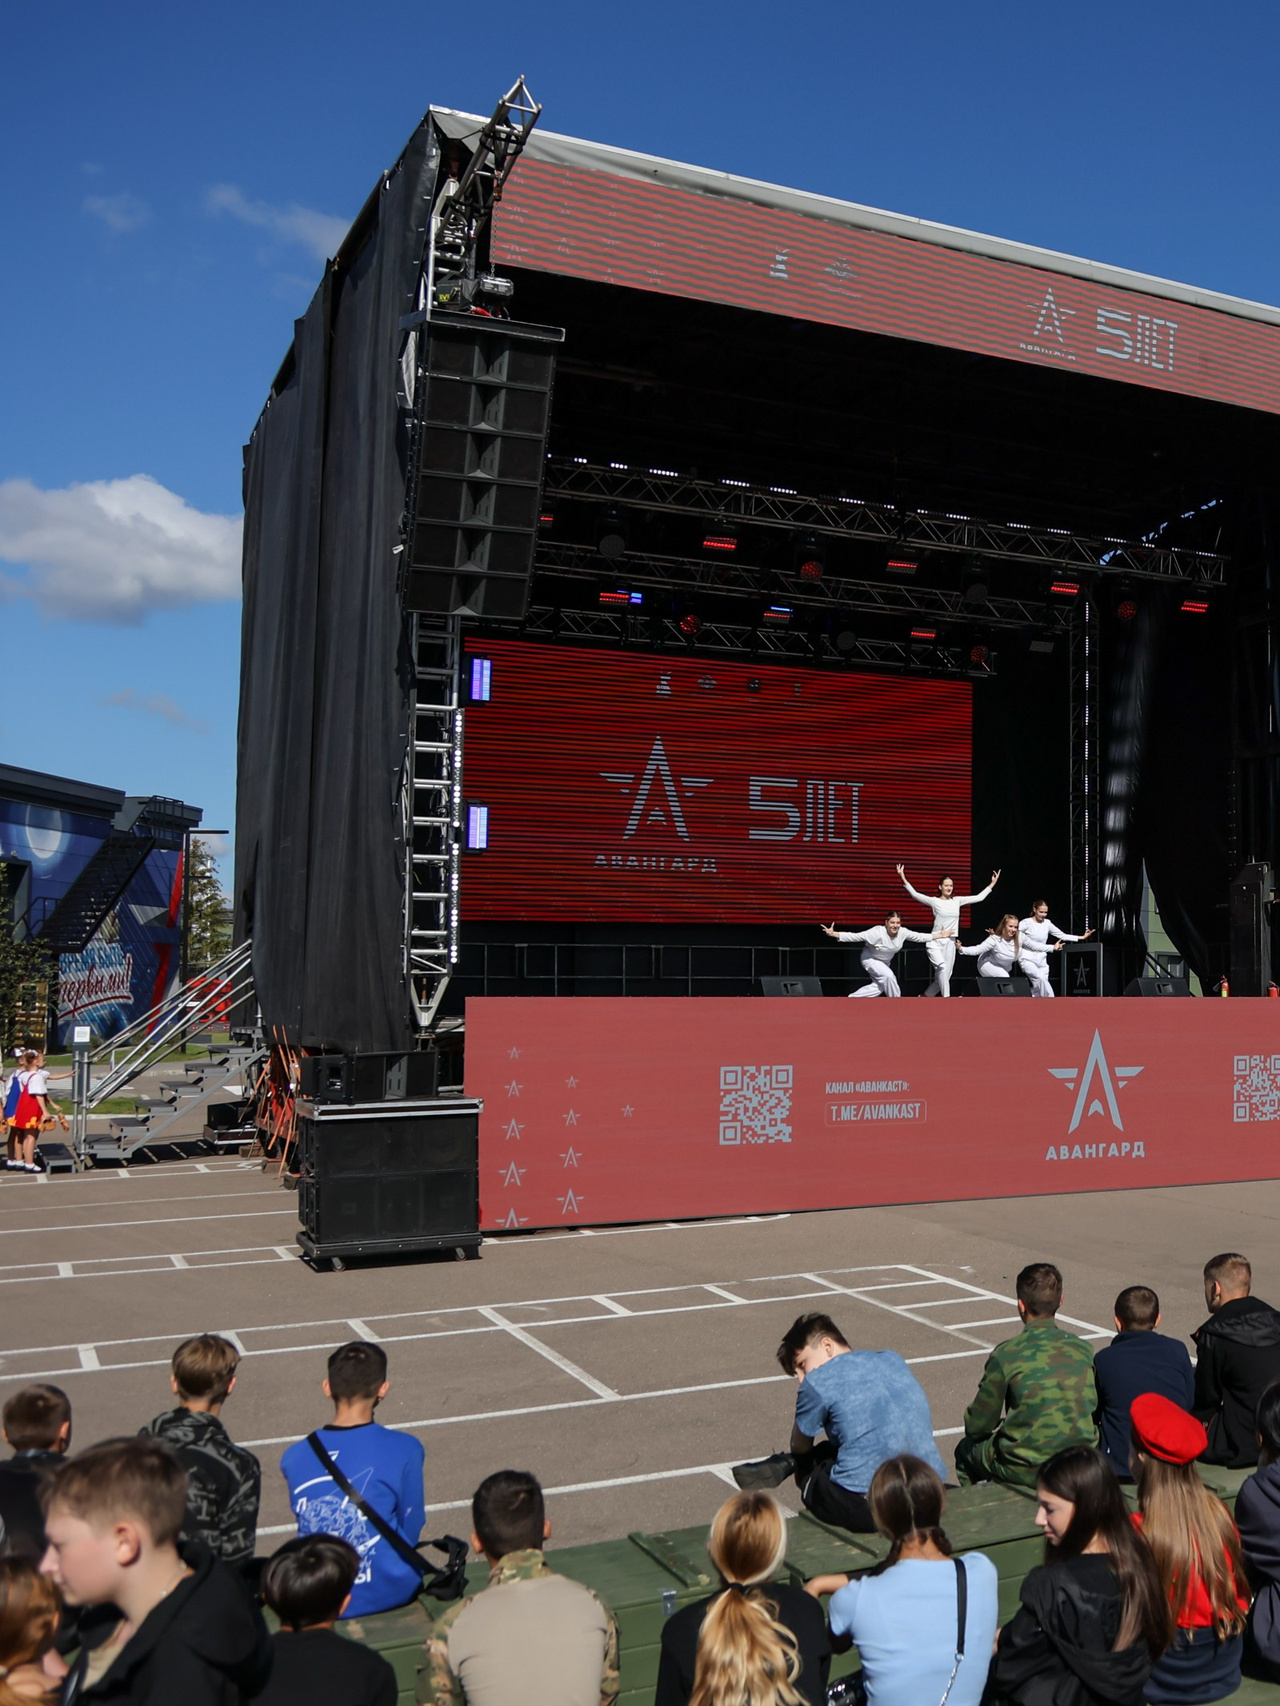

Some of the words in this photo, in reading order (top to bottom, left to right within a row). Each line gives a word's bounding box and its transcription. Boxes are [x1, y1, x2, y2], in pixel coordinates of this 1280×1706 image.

[593, 854, 717, 873] АВАНГАРД
[825, 1081, 854, 1094] КАНАЛ
[855, 1080, 910, 1093] «АВАНКАСТ»:
[830, 1103, 921, 1121] T.ME/AVANKAST
[1045, 1141, 1145, 1160] АВАНГАРД
